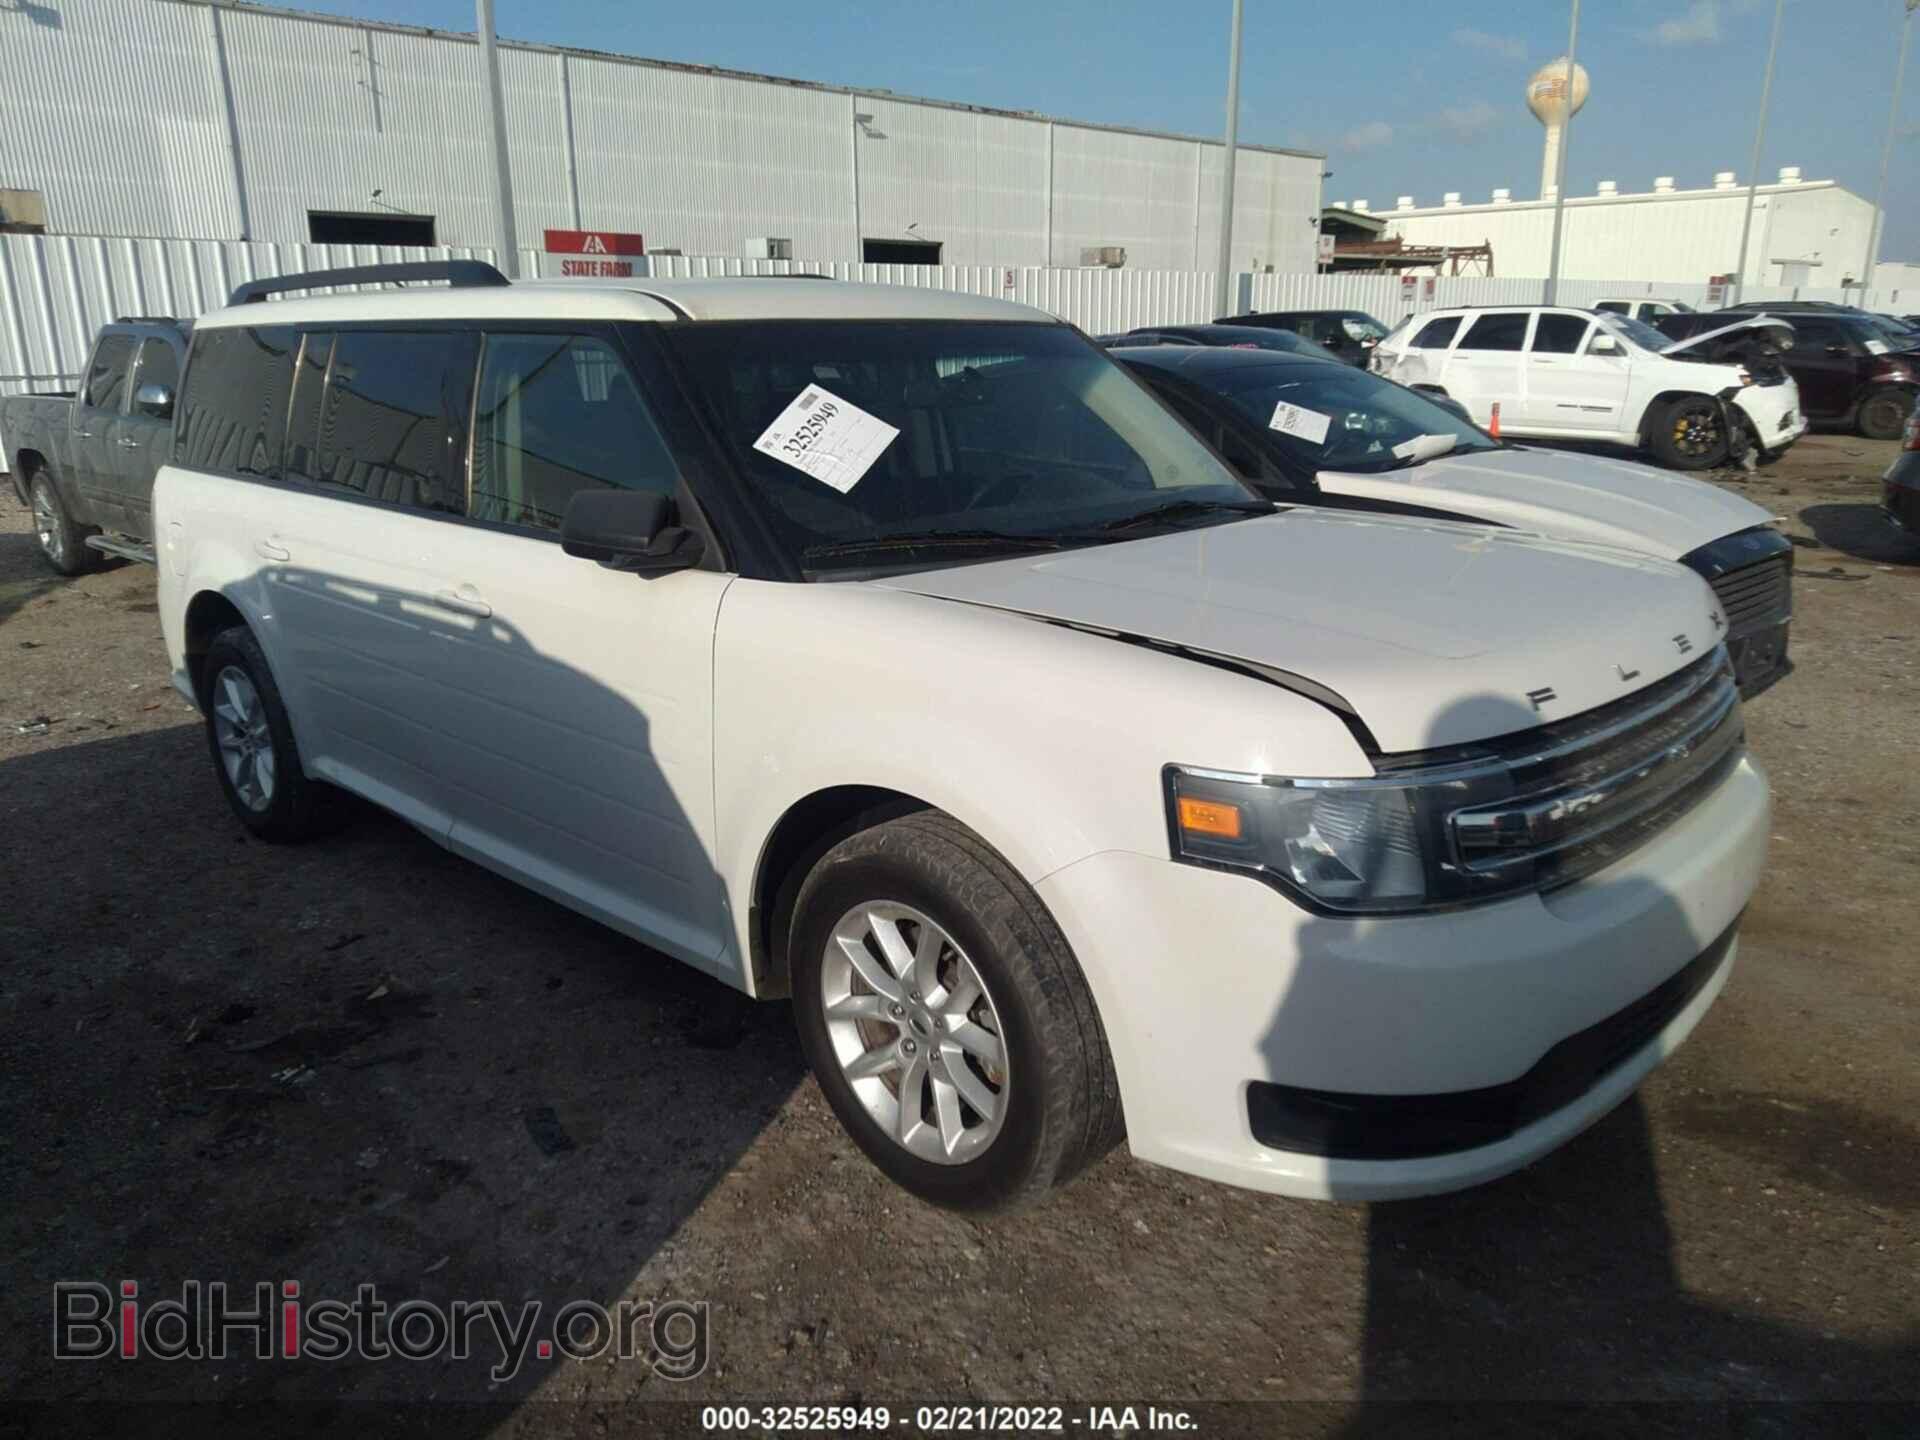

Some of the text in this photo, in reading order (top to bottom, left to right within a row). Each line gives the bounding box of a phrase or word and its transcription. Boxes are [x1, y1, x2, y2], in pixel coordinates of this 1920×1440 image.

[561, 260, 632, 277] STATE FARM
[1006, 271, 1013, 284] 5
[783, 402, 840, 458] 32525949
